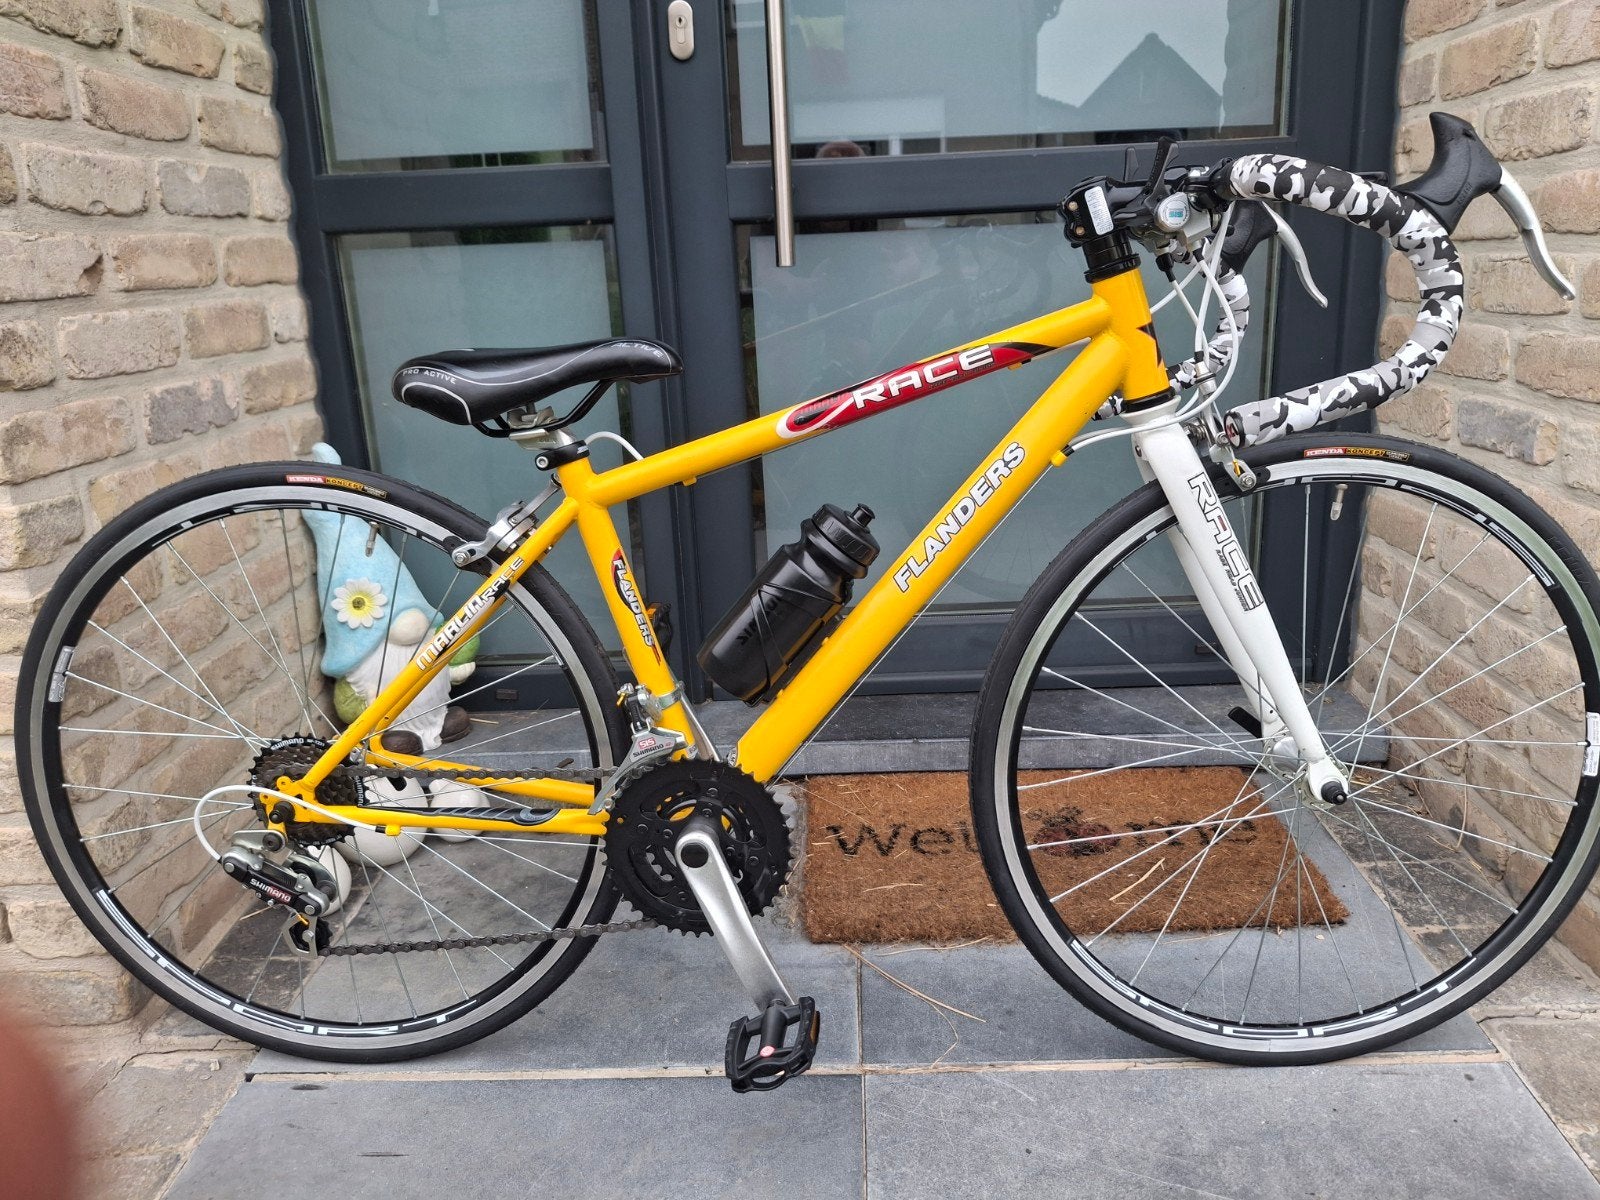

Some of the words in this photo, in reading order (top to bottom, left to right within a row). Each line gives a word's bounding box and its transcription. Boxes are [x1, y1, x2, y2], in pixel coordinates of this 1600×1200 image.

[402, 368, 420, 377] PRO
[424, 369, 457, 385] ACTIVE
[851, 344, 995, 410] RACE
[1306, 448, 1345, 457] KENDA
[892, 441, 1026, 594] FLANDERS
[1187, 472, 1265, 611] RACE
[482, 557, 524, 602] RACE
[612, 559, 655, 647] FLANDERS
[271, 738, 304, 750] SHIMANO
[633, 743, 665, 757] SHIMANO
[639, 738, 656, 749] SIS
[249, 877, 292, 903] SHIMANO
[99, 889, 478, 1036] SPORT
[1072, 940, 1477, 1039] SPORT
